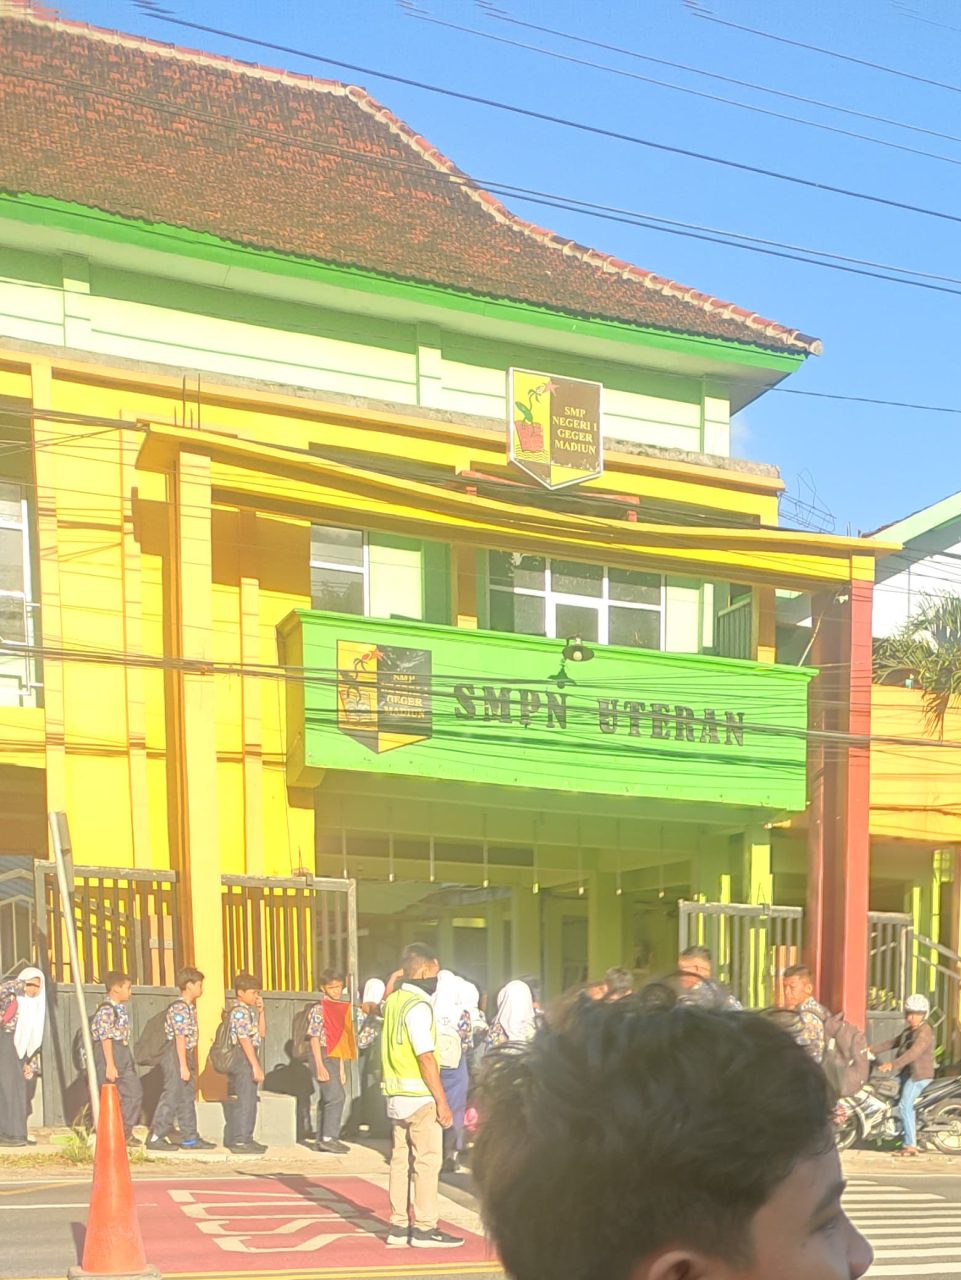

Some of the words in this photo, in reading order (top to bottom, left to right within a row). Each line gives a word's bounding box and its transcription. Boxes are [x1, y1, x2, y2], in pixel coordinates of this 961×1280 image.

[564, 406, 586, 417] SMP
[552, 415, 591, 431] NEGERI
[557, 428, 593, 443] GEGER
[554, 439, 597, 455] MADIUN
[453, 683, 568, 729] SMPN
[596, 698, 746, 746] UTERAN
